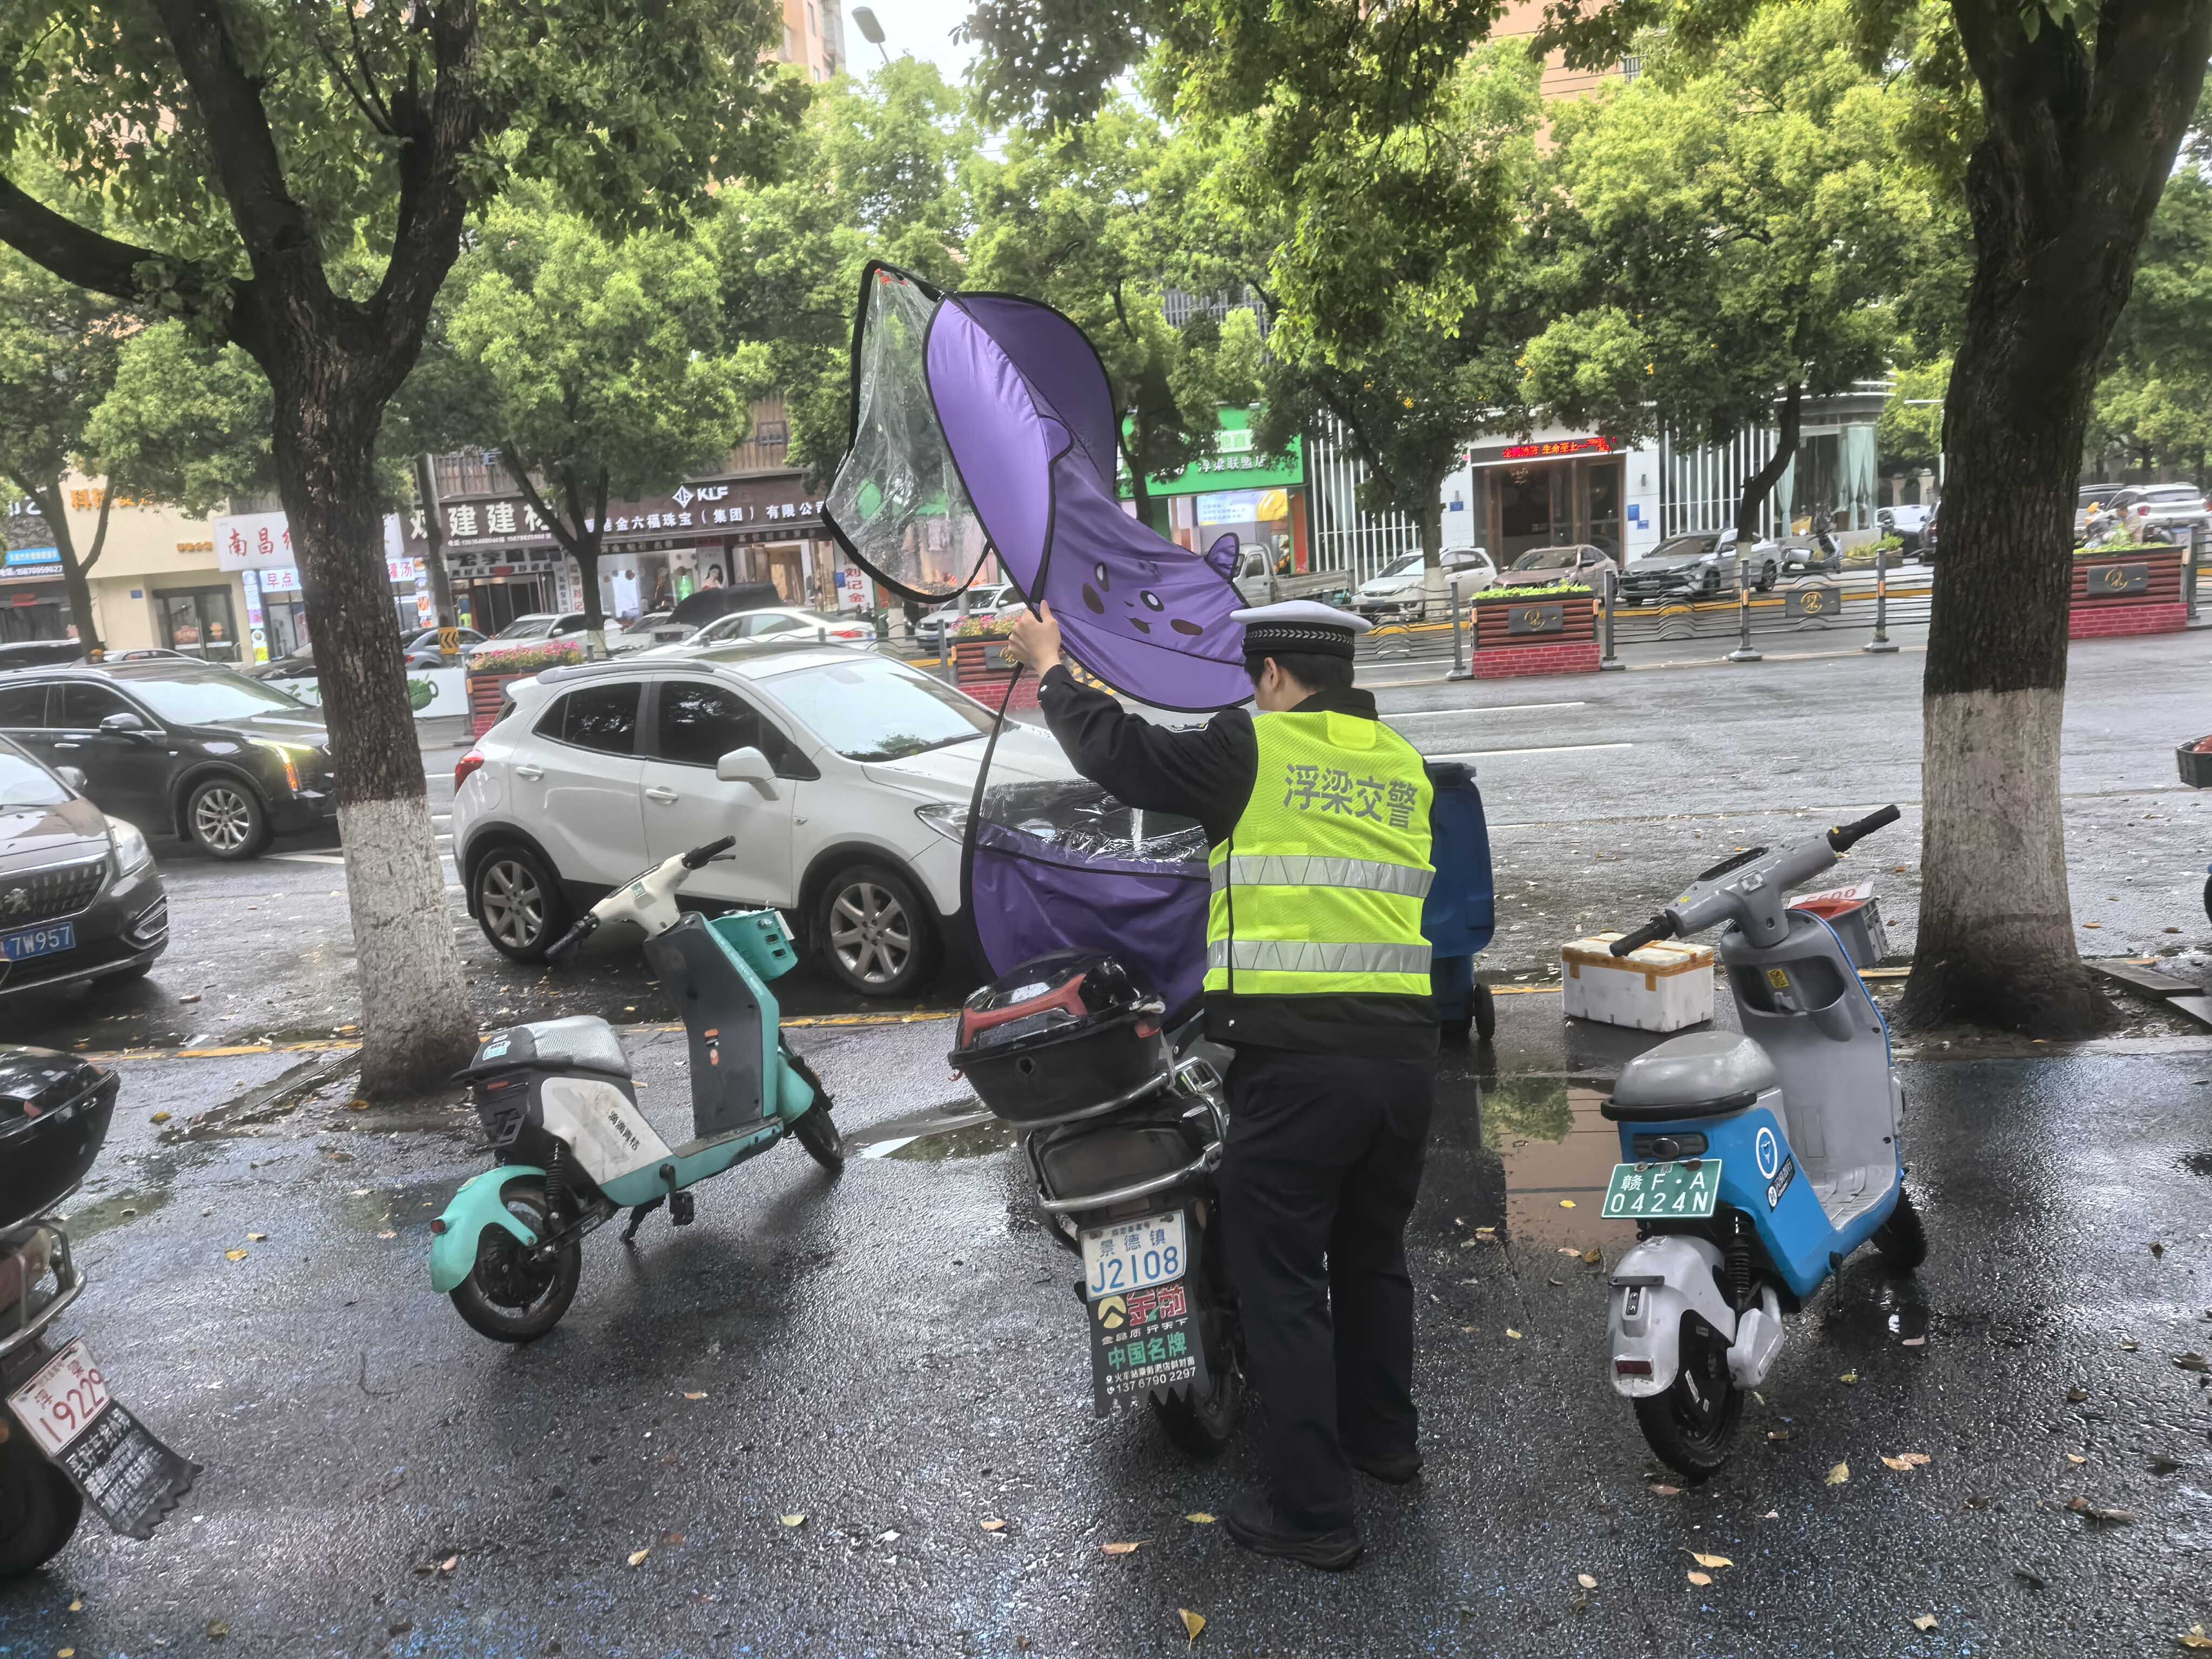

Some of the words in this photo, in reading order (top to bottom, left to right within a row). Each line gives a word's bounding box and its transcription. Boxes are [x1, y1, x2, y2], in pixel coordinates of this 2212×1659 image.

[1542, 442, 1579, 454] 生命至上
[697, 486, 728, 501] KLF
[267, 571, 293, 588] 早点
[1283, 763, 1417, 829] 浮梁交警
[10, 926, 70, 956] 7W957
[1610, 1191, 1708, 1212] 0424N
[1100, 1228, 1166, 1257] 景德镇
[1091, 1246, 1178, 1293] J2108
[1108, 1331, 1187, 1370] 中国名牌
[1116, 1379, 1135, 1393] 137
[1138, 1374, 1166, 1388] 6790
[1169, 1367, 1196, 1381] 2297
